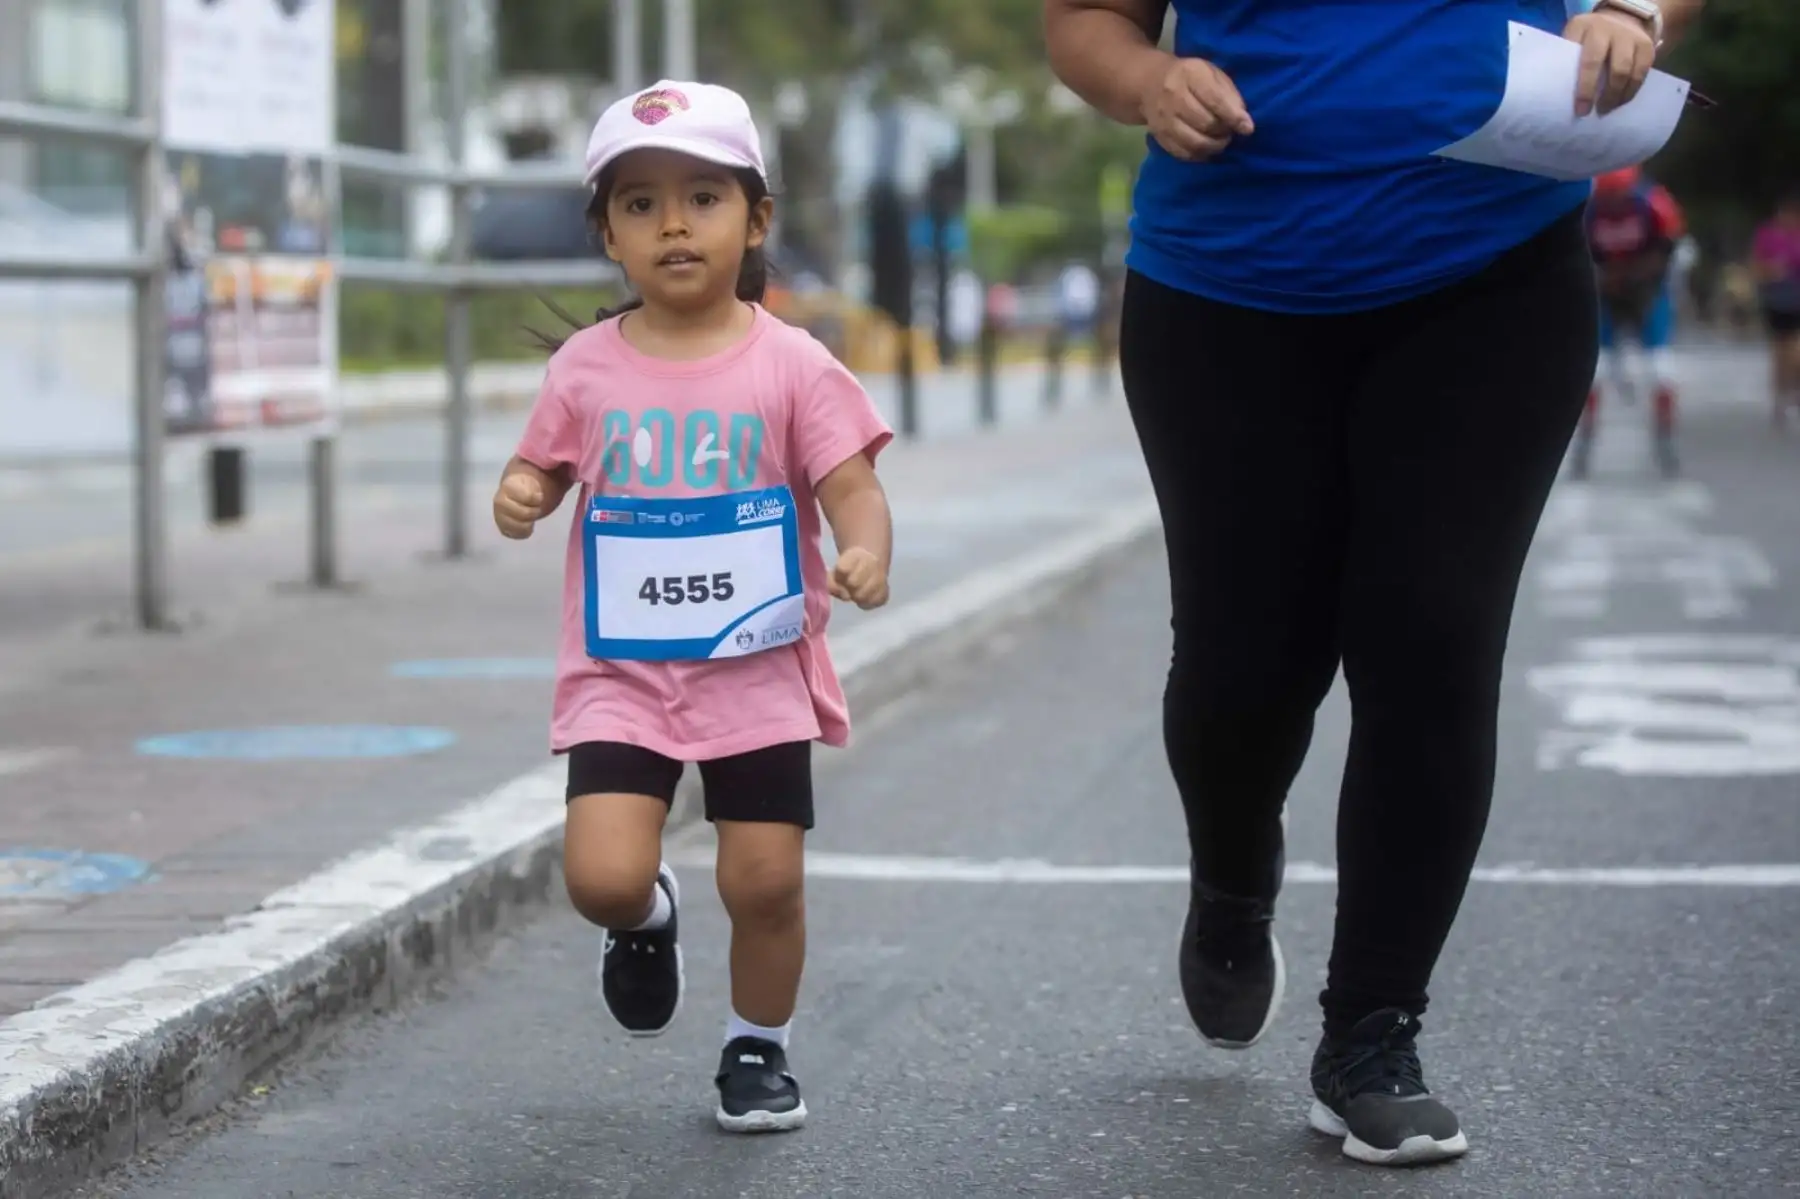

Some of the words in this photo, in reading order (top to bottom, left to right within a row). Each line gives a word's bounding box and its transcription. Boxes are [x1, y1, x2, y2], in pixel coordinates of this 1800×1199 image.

[602, 408, 764, 489] GOOD
[757, 498, 780, 510] LIMA
[639, 572, 735, 606] 4555
[761, 627, 800, 645] LIMA
